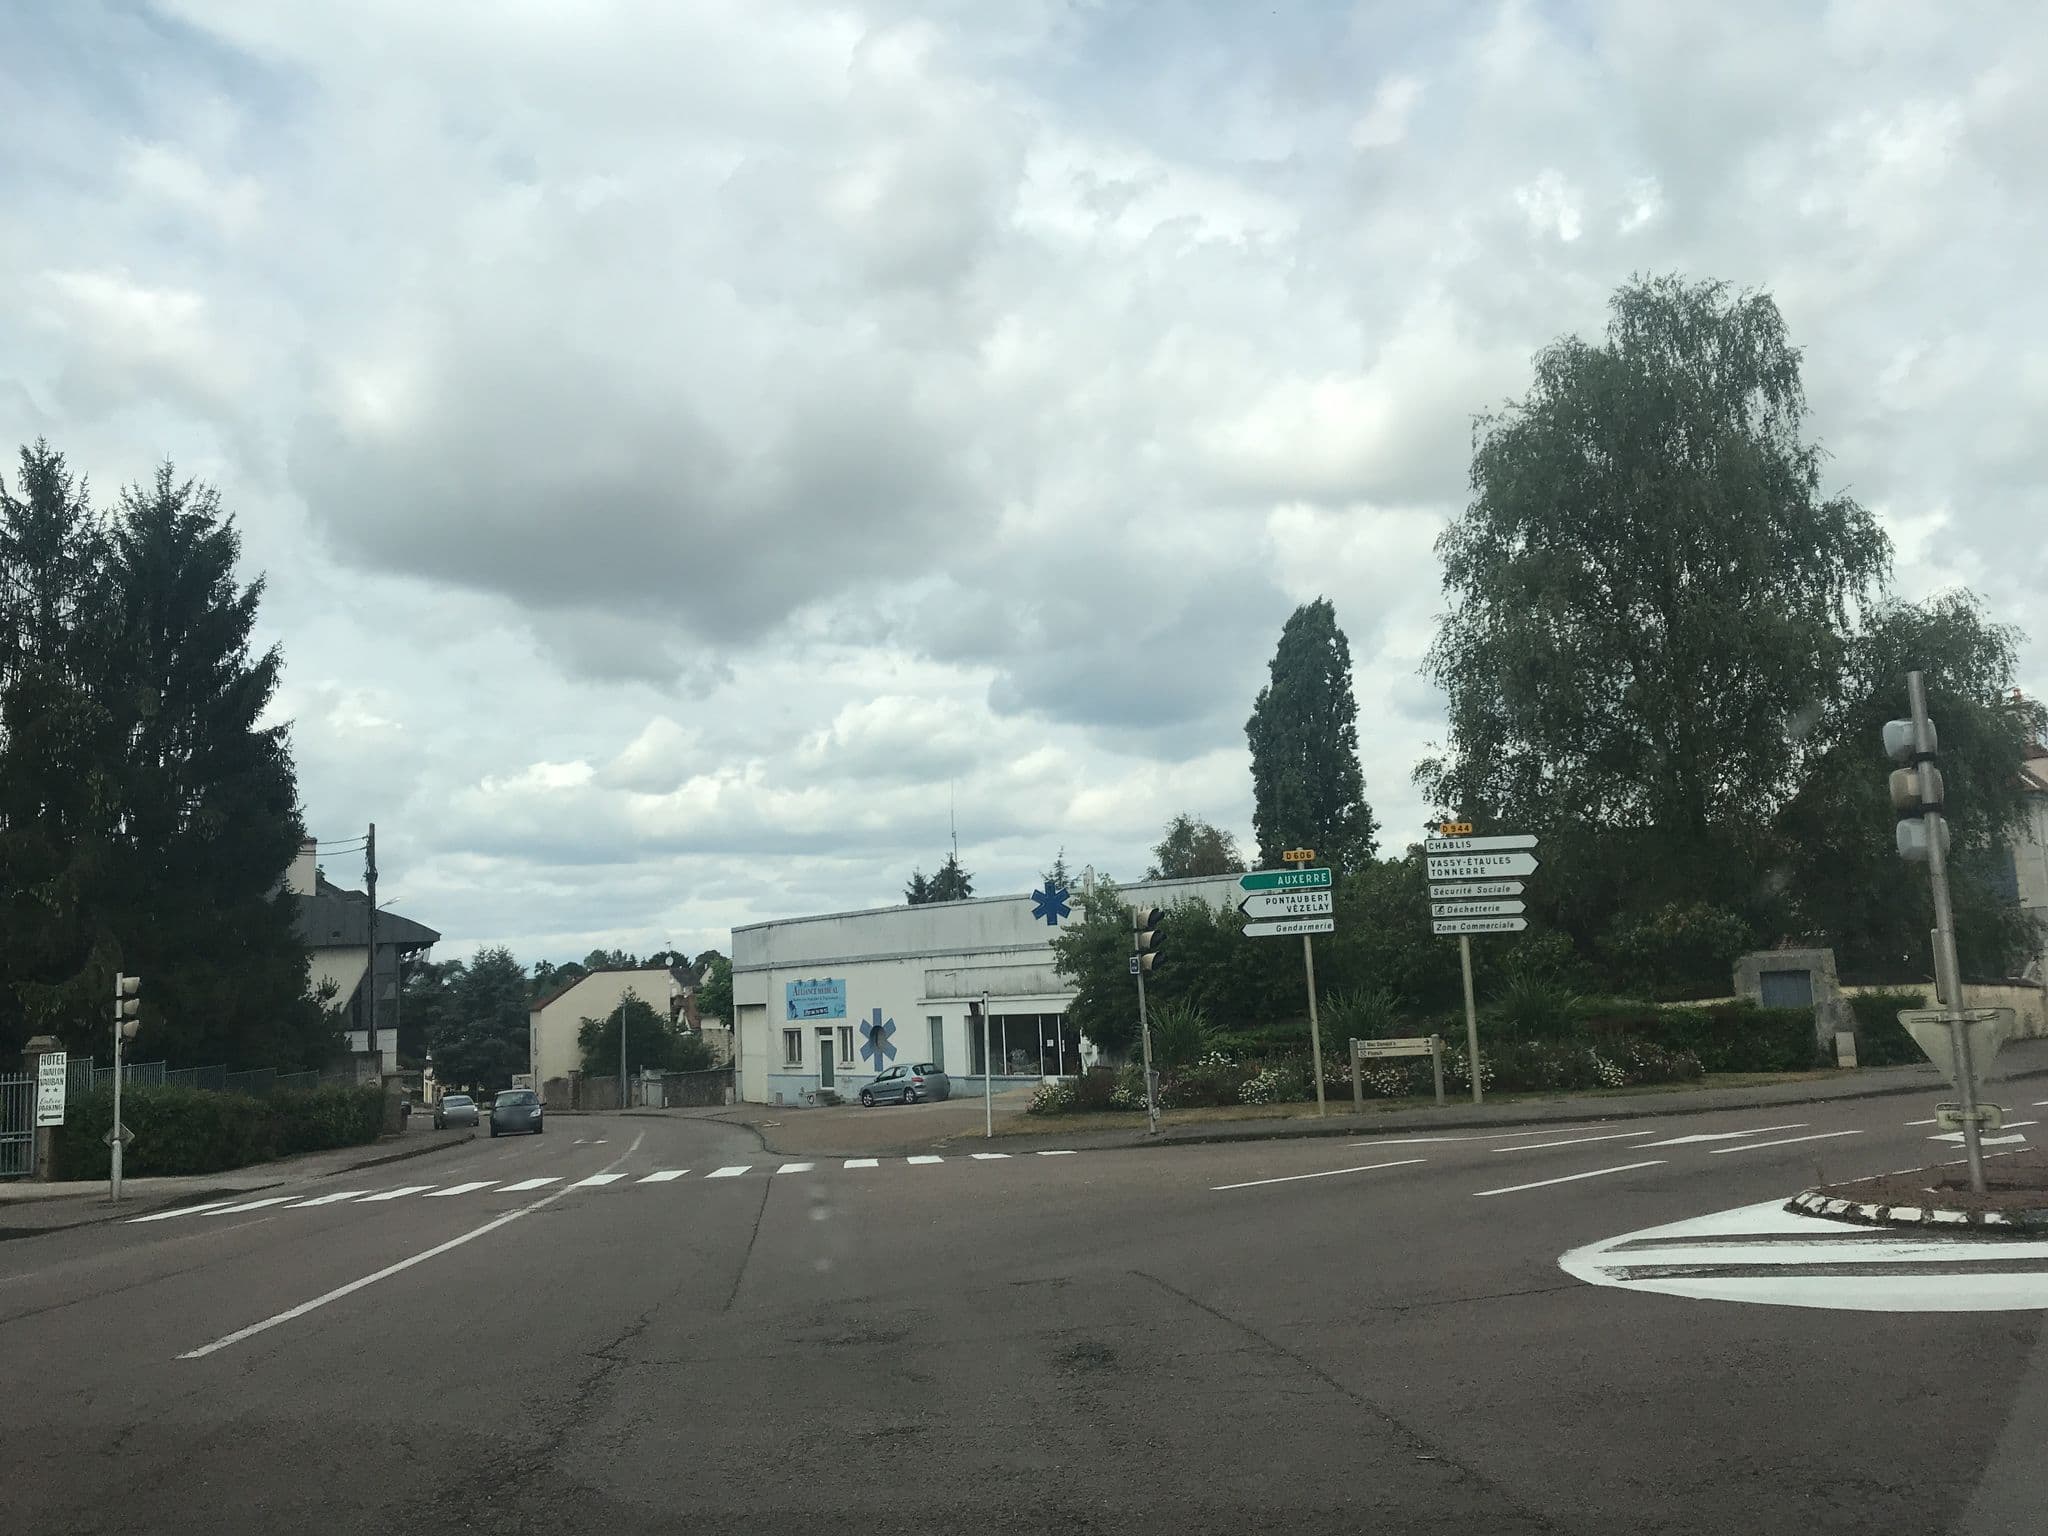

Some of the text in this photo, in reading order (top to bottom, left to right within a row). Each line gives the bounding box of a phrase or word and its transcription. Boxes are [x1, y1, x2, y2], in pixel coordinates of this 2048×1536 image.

[1451, 824, 1470, 832] 944
[1429, 841, 1472, 849] CHABLIS
[1294, 851, 1312, 859] 606
[1430, 856, 1512, 867] VASSY-ÉTAULES
[1431, 867, 1486, 877] TONNERRE
[1278, 873, 1328, 884] AUXERRE
[1433, 885, 1511, 896] Sécurité Sociale
[1266, 894, 1329, 905] PONTAUBERT
[1287, 904, 1329, 912] VÉZELAY
[1447, 905, 1500, 914] Déchetterie
[1276, 922, 1333, 933] Gendarmerie
[1436, 920, 1514, 931] Zone Commerciale
[40, 1055, 65, 1066] HOTEL
[39, 1104, 63, 1112] PARKING
